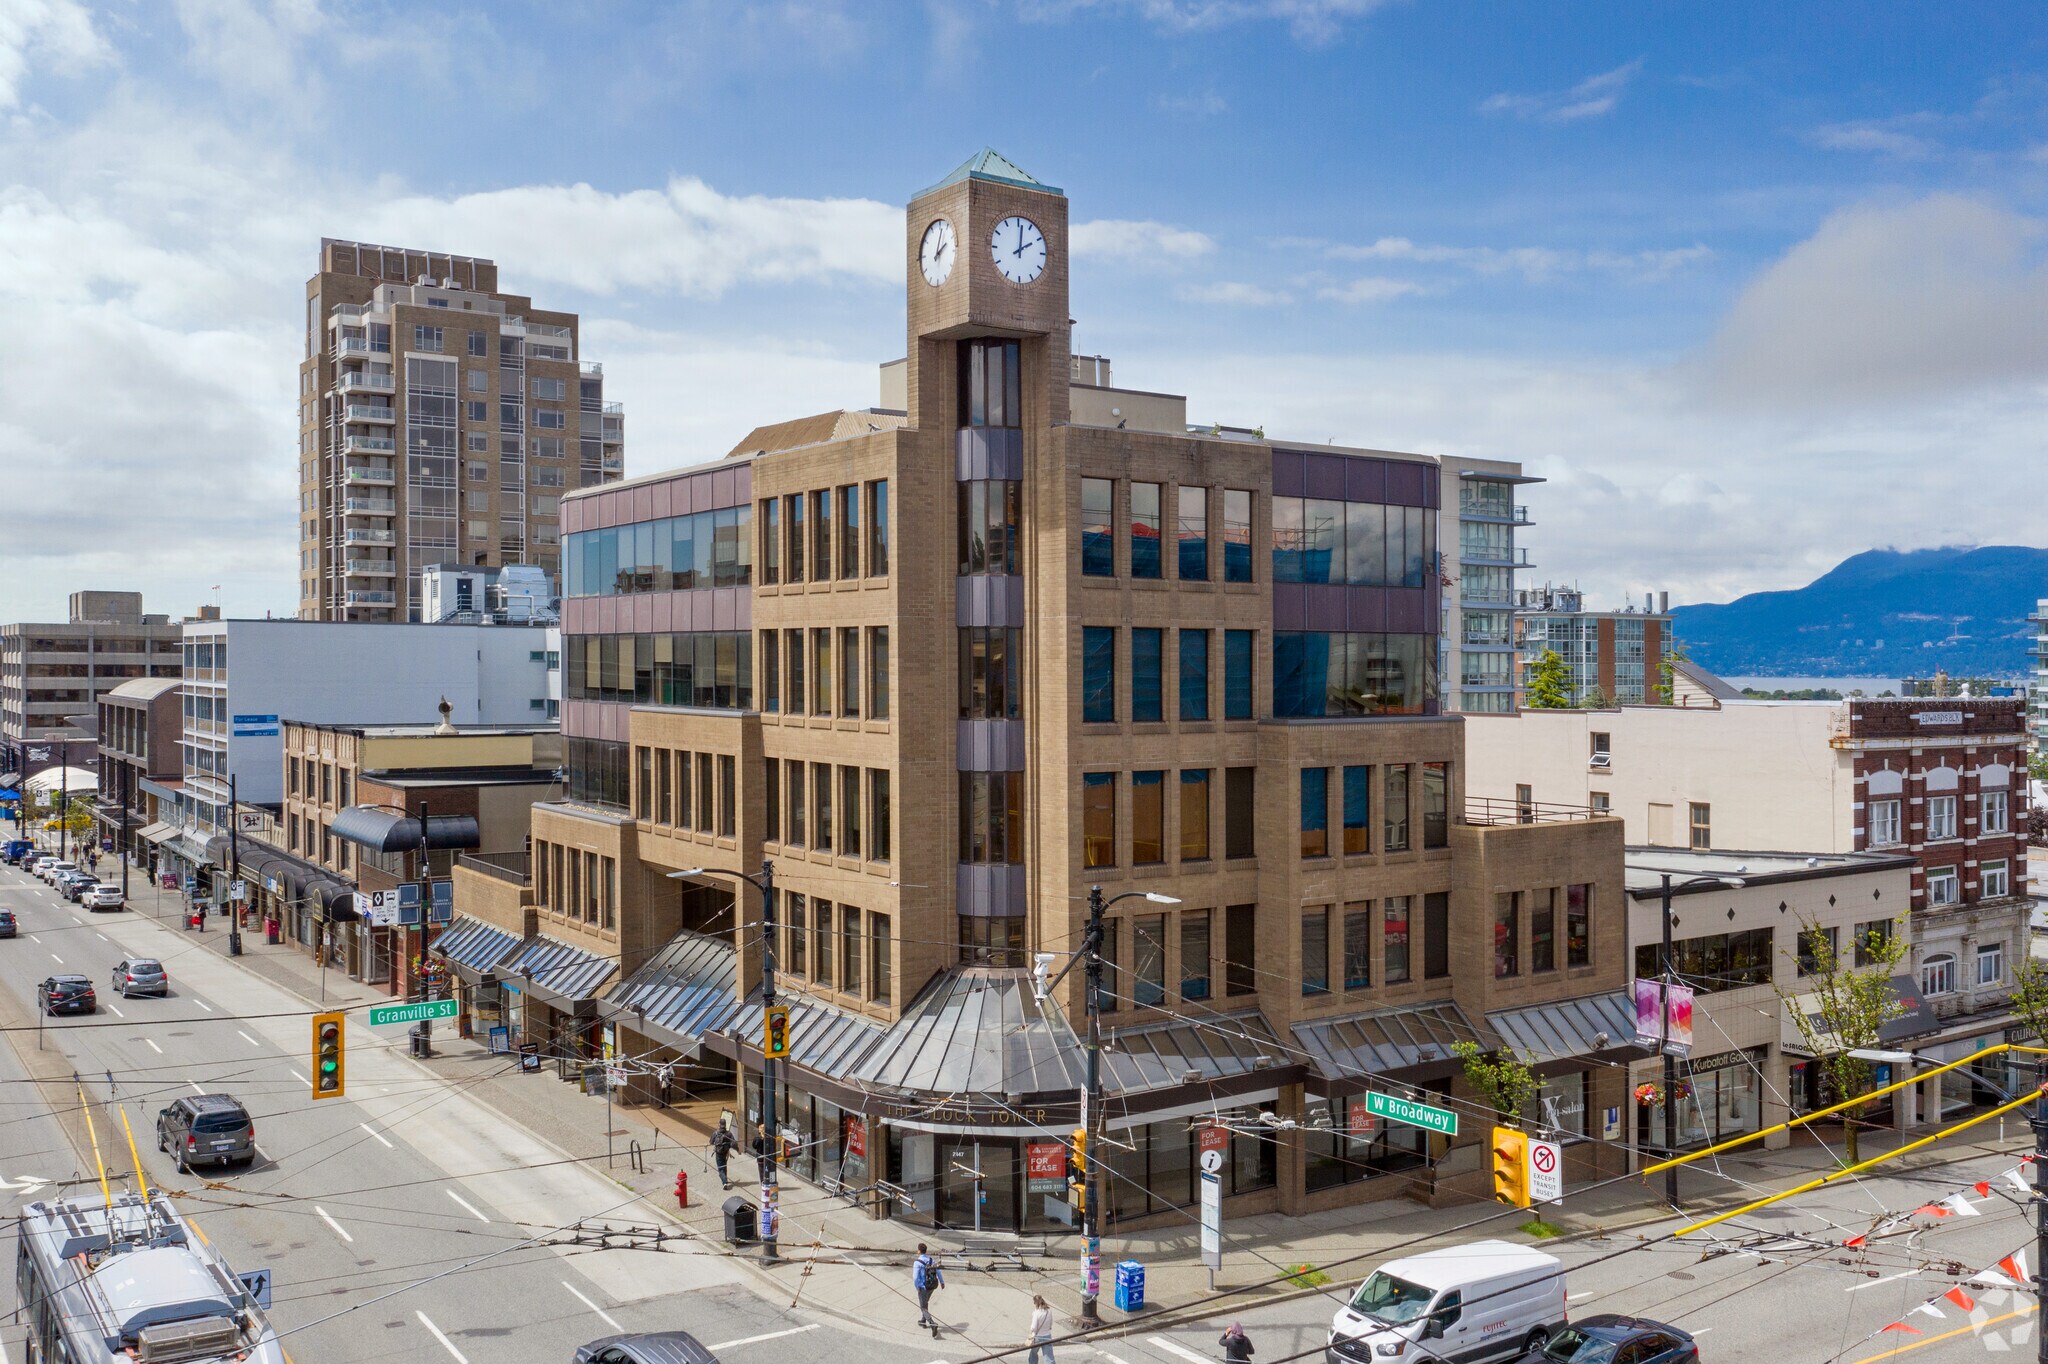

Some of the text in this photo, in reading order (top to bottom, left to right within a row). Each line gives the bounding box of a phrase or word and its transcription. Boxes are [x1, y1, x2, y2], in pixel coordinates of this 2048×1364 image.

[377, 1003, 451, 1023] Granville St
[1693, 1050, 1756, 1073] Kurbatoff Gallery
[886, 1104, 1047, 1123] THE CLOCK TOWER
[1374, 1096, 1449, 1130] W Broadway
[1351, 1120, 1370, 1129] LEASE
[1201, 1131, 1215, 1139] FOR
[1201, 1137, 1222, 1147] LEASE
[1030, 1157, 1048, 1165] FOR
[1030, 1164, 1058, 1172] LEASE
[1533, 1172, 1556, 1183] EXCEPT
[1533, 1180, 1556, 1191] TRANSIT
[1535, 1188, 1554, 1198] BUSES
[1483, 1320, 1507, 1333] FUJITEC
